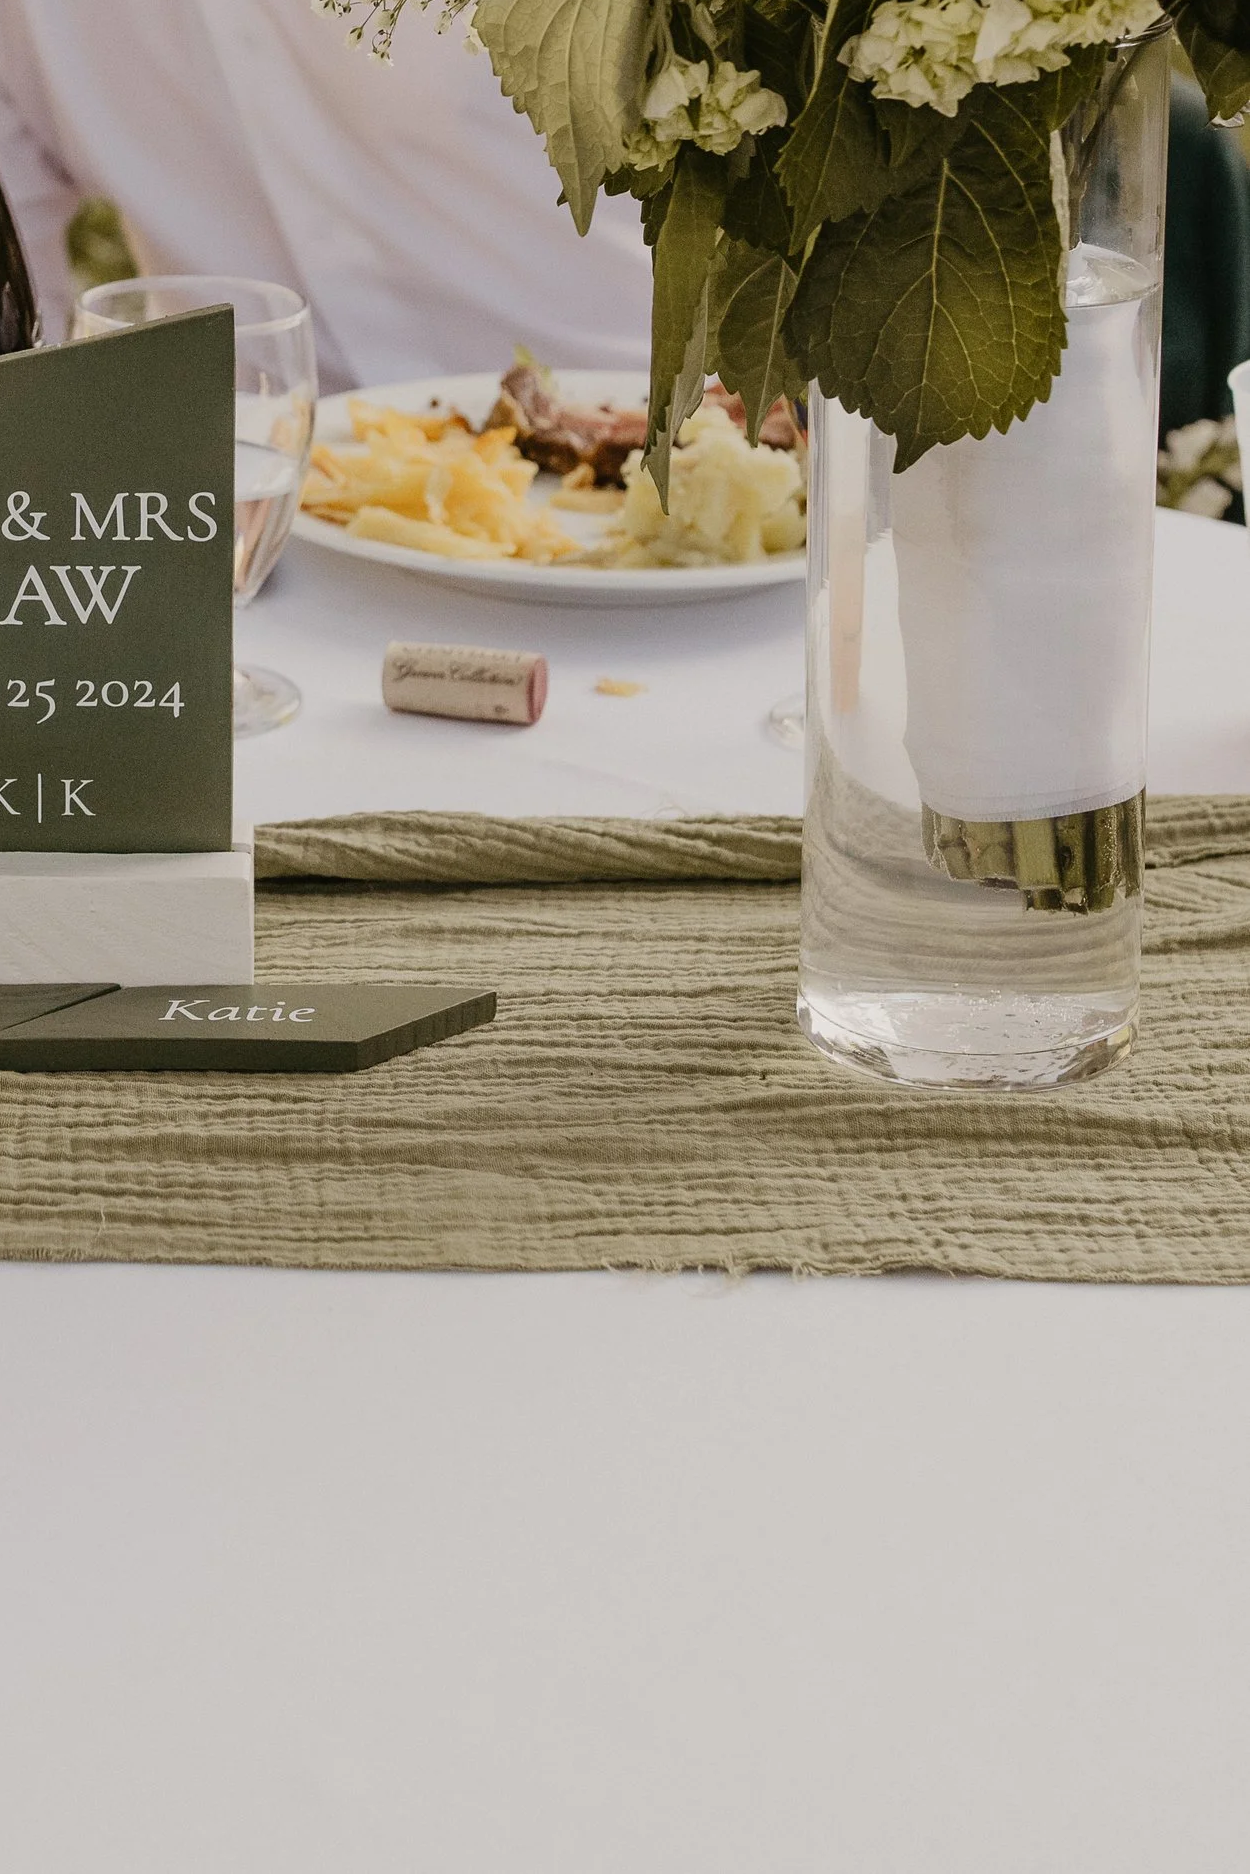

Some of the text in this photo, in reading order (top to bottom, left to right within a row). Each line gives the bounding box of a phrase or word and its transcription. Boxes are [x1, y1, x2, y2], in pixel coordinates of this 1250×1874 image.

[0, 490, 51, 542] &
[70, 491, 218, 542] MRS
[6, 678, 56, 725] 25
[75, 679, 185, 719] 2024
[157, 998, 317, 1024] Katie
